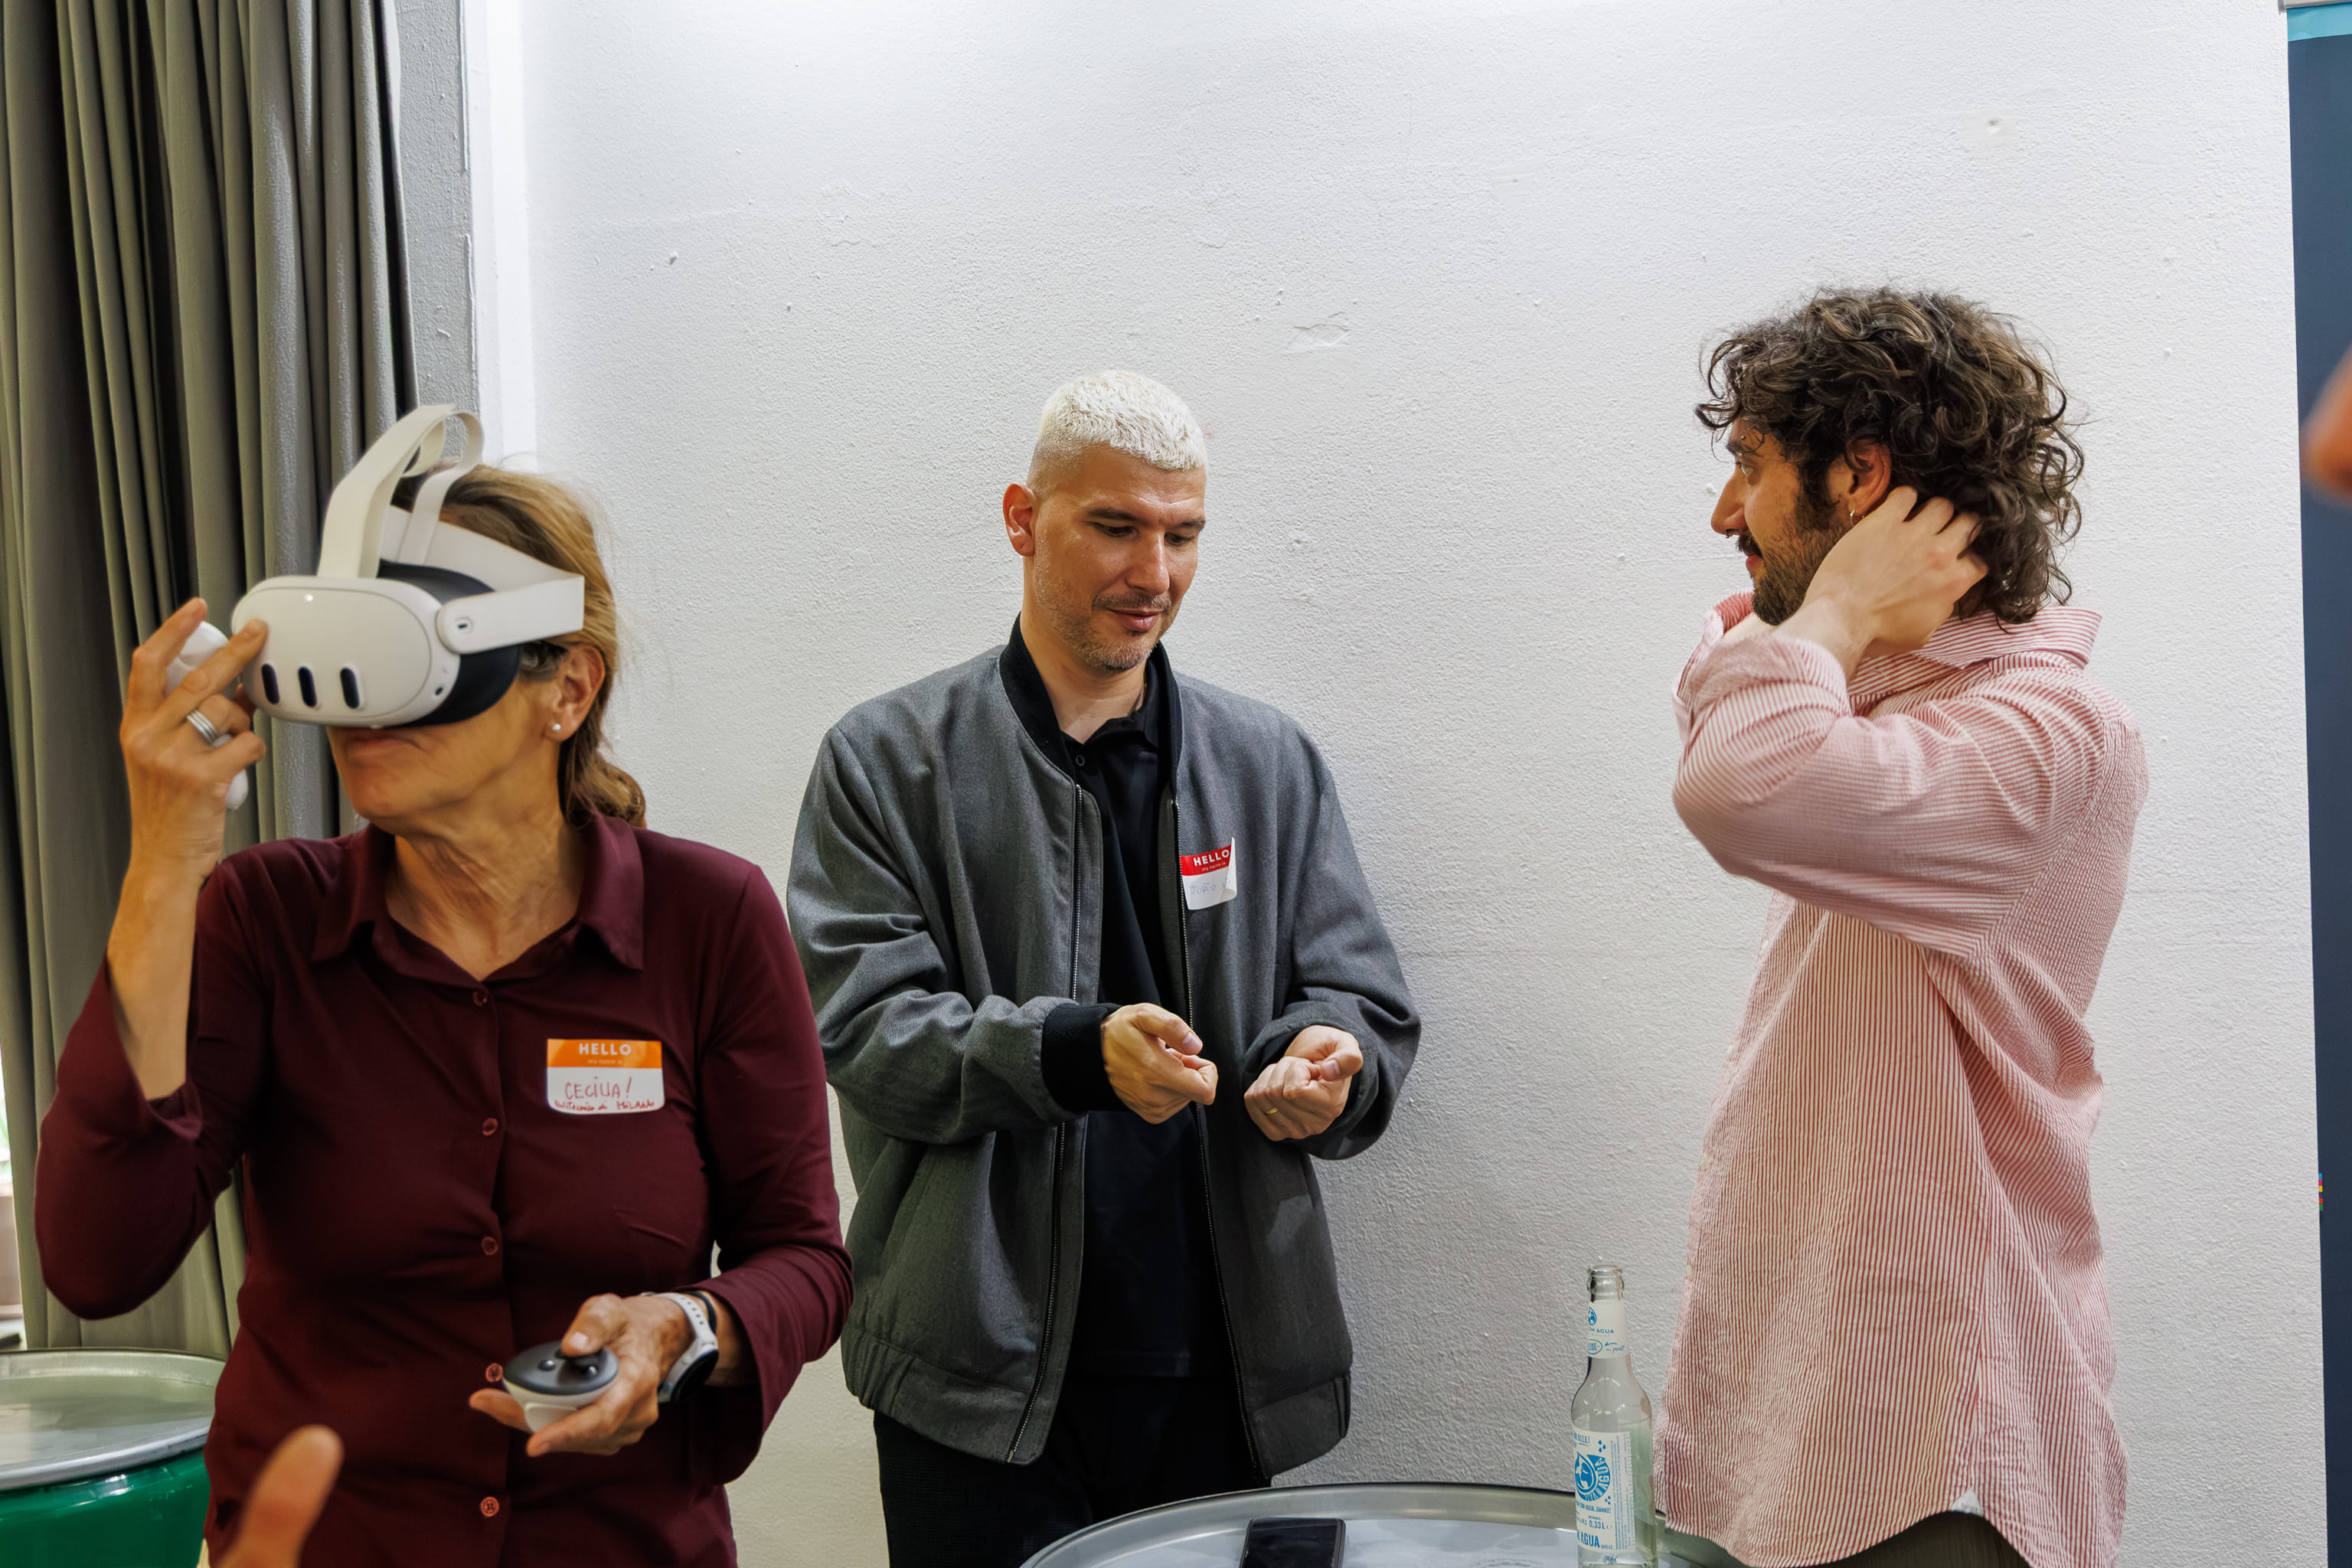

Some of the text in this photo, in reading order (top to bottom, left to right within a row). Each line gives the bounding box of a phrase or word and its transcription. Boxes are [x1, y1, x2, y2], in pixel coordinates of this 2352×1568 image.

[1193, 849, 1230, 866] HELLO
[579, 1042, 632, 1056] HELLO
[1580, 1531, 1600, 1548] AGUA
